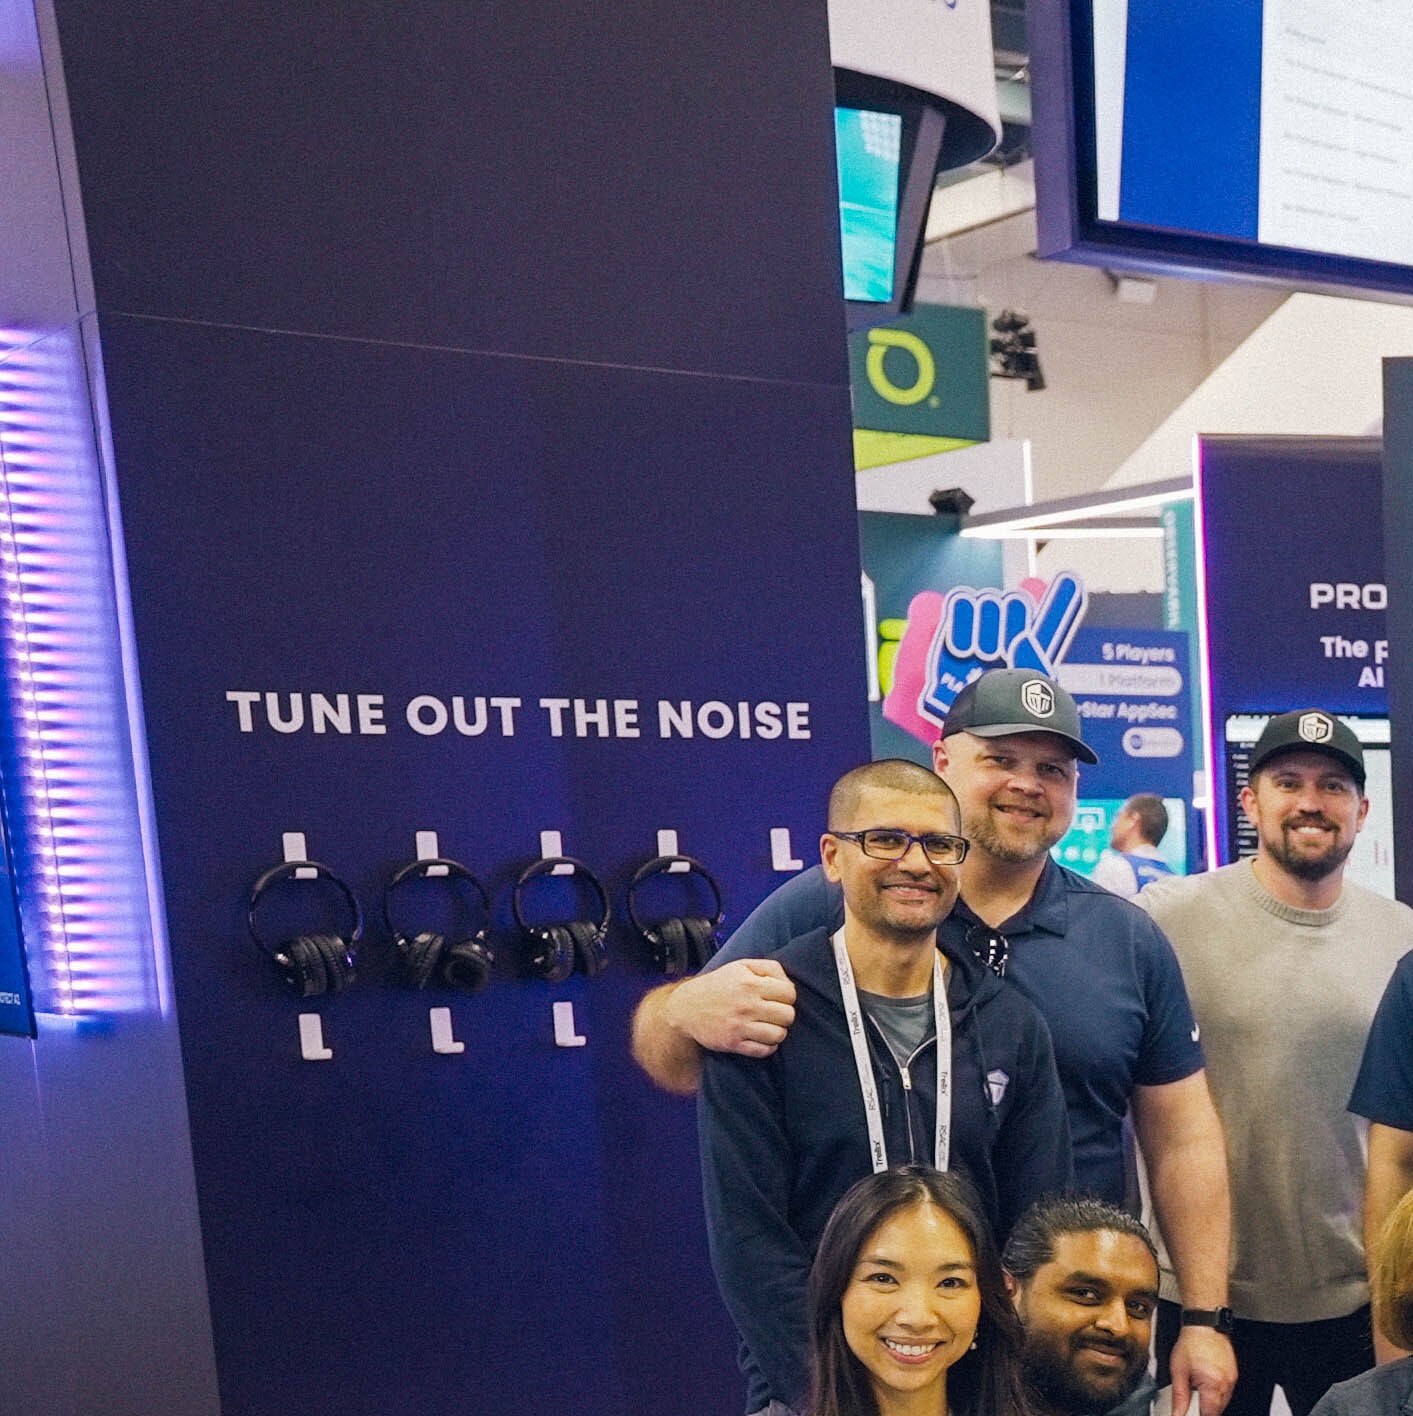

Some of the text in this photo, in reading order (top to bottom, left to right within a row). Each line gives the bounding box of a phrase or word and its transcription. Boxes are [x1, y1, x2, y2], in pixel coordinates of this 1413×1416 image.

[1310, 583, 1388, 610] PRO
[1320, 635, 1369, 658] The
[226, 690, 811, 739] TUNE OUT THE NOISE
